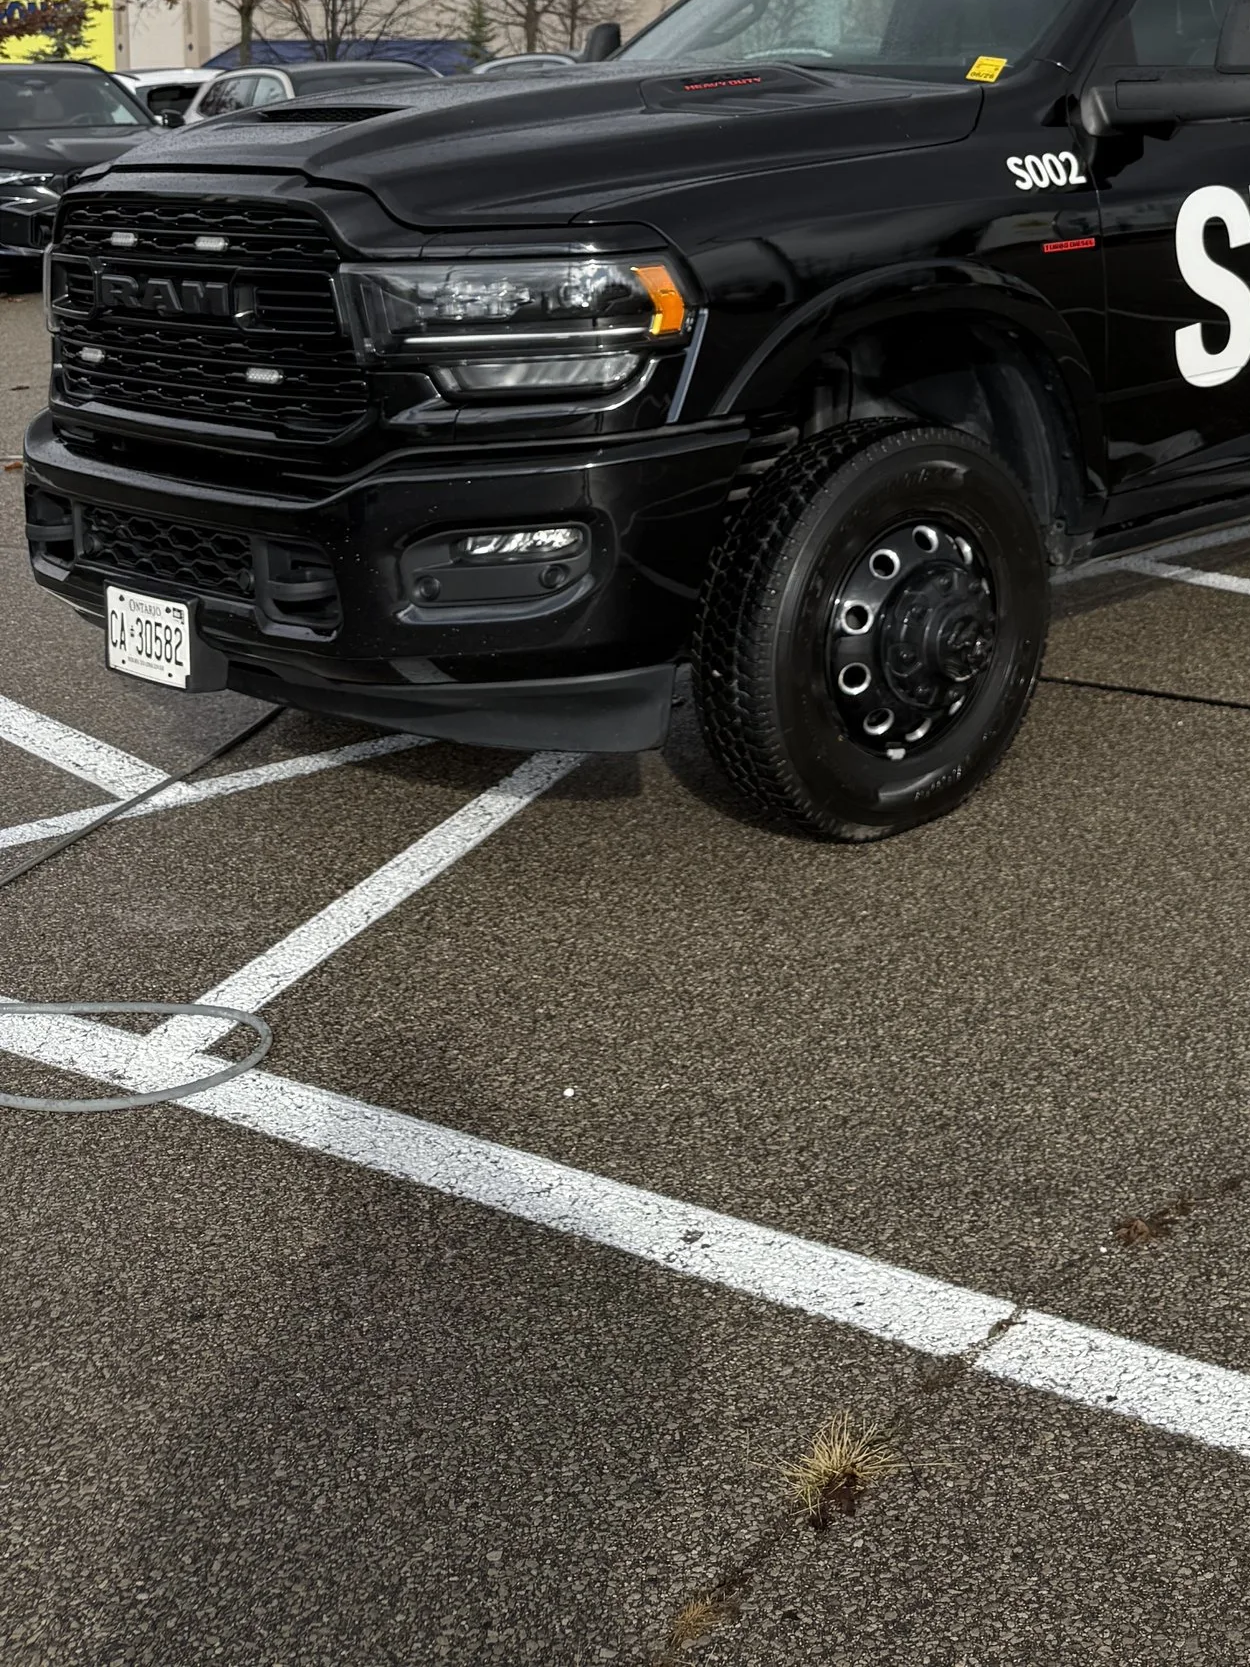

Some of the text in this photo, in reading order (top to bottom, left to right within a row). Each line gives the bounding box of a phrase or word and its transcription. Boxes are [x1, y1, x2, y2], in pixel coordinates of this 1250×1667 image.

[684, 80, 726, 91] HEAVY
[728, 76, 761, 87] DUTY
[1006, 151, 1087, 191] S002
[101, 274, 230, 316] RAM
